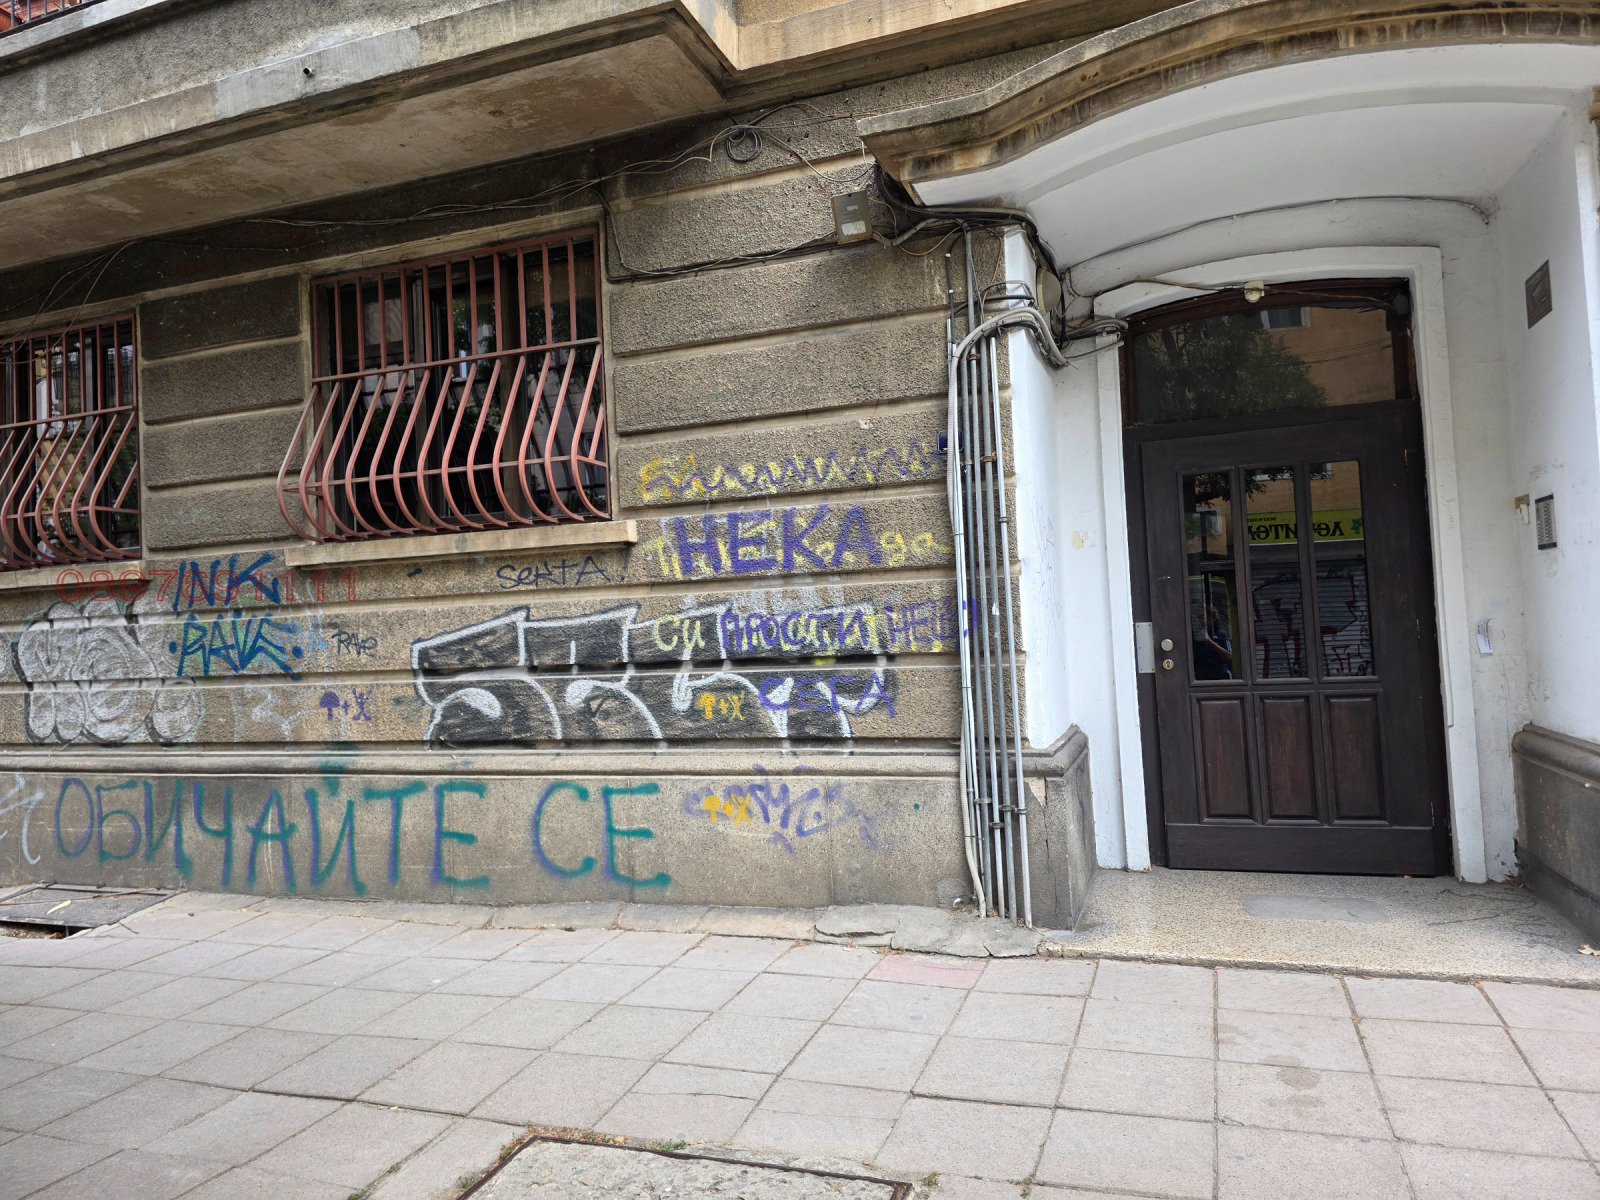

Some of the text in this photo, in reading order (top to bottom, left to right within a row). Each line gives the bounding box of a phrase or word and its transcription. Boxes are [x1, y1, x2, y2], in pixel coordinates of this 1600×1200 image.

[674, 504, 882, 575] НЕКА
[55, 744, 490, 897] ОБИЧАЙТЕ
[532, 781, 672, 888] СЕ
